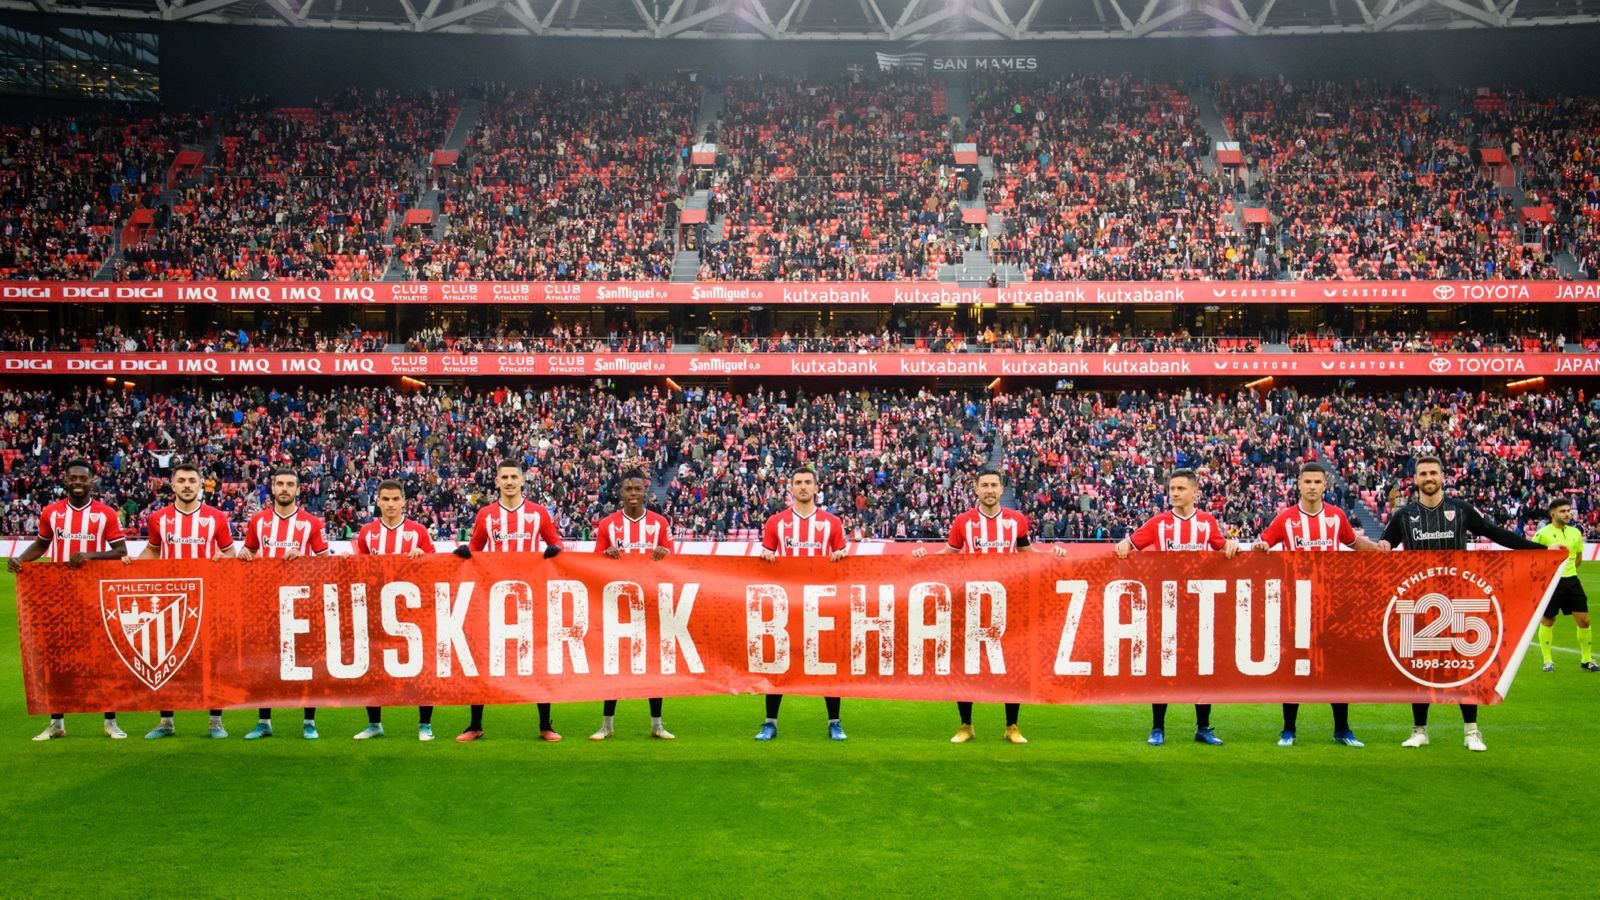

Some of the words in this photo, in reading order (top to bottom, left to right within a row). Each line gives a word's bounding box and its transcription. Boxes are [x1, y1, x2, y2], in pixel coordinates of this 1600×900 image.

[932, 58, 968, 70] SAN
[975, 58, 1038, 70] MAMES
[4, 287, 49, 298] DIGI
[64, 287, 109, 298] DIGI
[117, 287, 162, 298] DIGI
[179, 286, 219, 300] IMQ
[231, 286, 271, 300] IMQ
[282, 286, 322, 300] IMQ
[335, 286, 375, 300] IMQ
[391, 284, 428, 293] CLUB
[442, 284, 479, 293] CLUB
[493, 284, 530, 293] CLUB
[545, 284, 582, 293] CLUB
[784, 287, 870, 302] kutxabank
[894, 288, 982, 303] kutxabank
[997, 286, 1085, 302] kutxabank
[1097, 286, 1184, 302] kutxabank
[1231, 289, 1297, 297] CASTORE
[1342, 289, 1407, 297] CASTORE
[1462, 285, 1530, 299] TOYOTA
[6, 359, 52, 370] DIGI
[68, 359, 113, 370] DIGI
[121, 359, 167, 370] DIGI
[179, 358, 219, 372] IMQ
[231, 358, 271, 372] IMQ
[282, 358, 322, 372] IMQ
[335, 358, 375, 372] IMQ
[391, 356, 428, 366] CLUB
[442, 356, 478, 366] CLUB
[498, 356, 535, 366] CLUB
[548, 356, 585, 366] CLUB
[792, 358, 878, 373] kutxabank
[901, 358, 987, 373] kutxabank
[1002, 358, 1089, 373] kutxabank
[1103, 358, 1190, 373] kutxabank
[1232, 361, 1298, 369] CASTORE
[1339, 361, 1405, 369] CASTORE
[1458, 358, 1526, 372] TOYOTA
[108, 584, 163, 593] ATHLETIC
[165, 582, 196, 591] CLUB
[1396, 567, 1458, 596] ATHLETIC
[1462, 570, 1493, 595] CLUB
[278, 580, 706, 681] EUSKARAK
[745, 581, 1008, 676] BEHAR
[1053, 579, 1313, 677] ZAITU!
[1395, 592, 1492, 658] 125
[134, 655, 177, 685] BILBAO
[1410, 659, 1475, 670] 1898-2023
